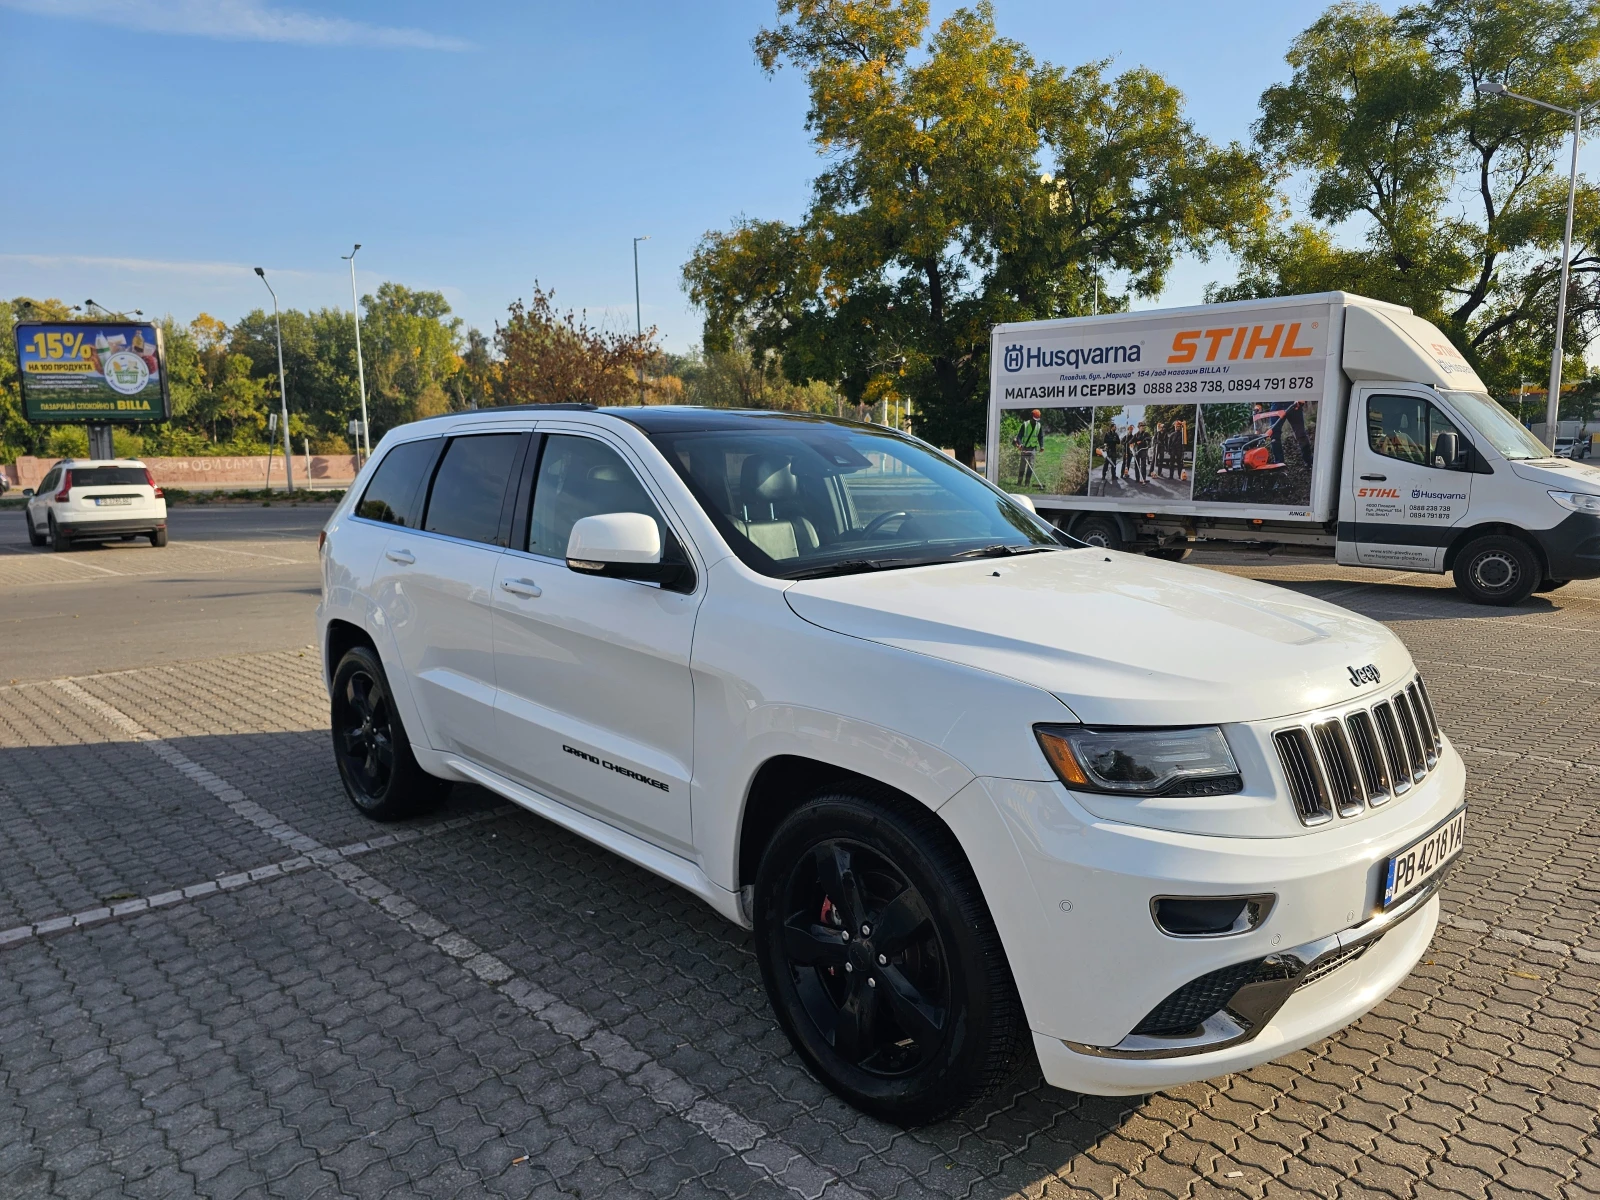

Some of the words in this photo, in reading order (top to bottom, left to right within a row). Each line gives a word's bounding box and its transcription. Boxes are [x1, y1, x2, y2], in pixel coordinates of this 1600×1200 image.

[25, 332, 92, 359] -15%
[1167, 322, 1314, 364] STIHL
[53, 364, 93, 372] ПРОДУКТА
[1026, 344, 1141, 369] Husqvarna
[1137, 370, 1150, 378] 154
[1199, 367, 1221, 375] BILLA
[1005, 385, 1065, 400] МАГАЗИН
[1068, 385, 1078, 397] И
[1080, 382, 1136, 397] СЕРВИЗ
[1143, 382, 1173, 395] 0888
[1175, 381, 1198, 393] 238
[1200, 380, 1225, 394] 738,
[1228, 379, 1261, 392] 0894
[1264, 378, 1285, 391] 791
[1288, 376, 1314, 389] 878
[117, 400, 151, 410] BILLA
[1357, 488, 1400, 498] STIHL
[1420, 491, 1467, 500] Husqvarna
[1347, 663, 1381, 688] Jeep
[562, 744, 600, 765] GRAND
[602, 760, 670, 793] CHEROKEE
[1394, 851, 1416, 895] PB
[1417, 831, 1448, 877] 4218
